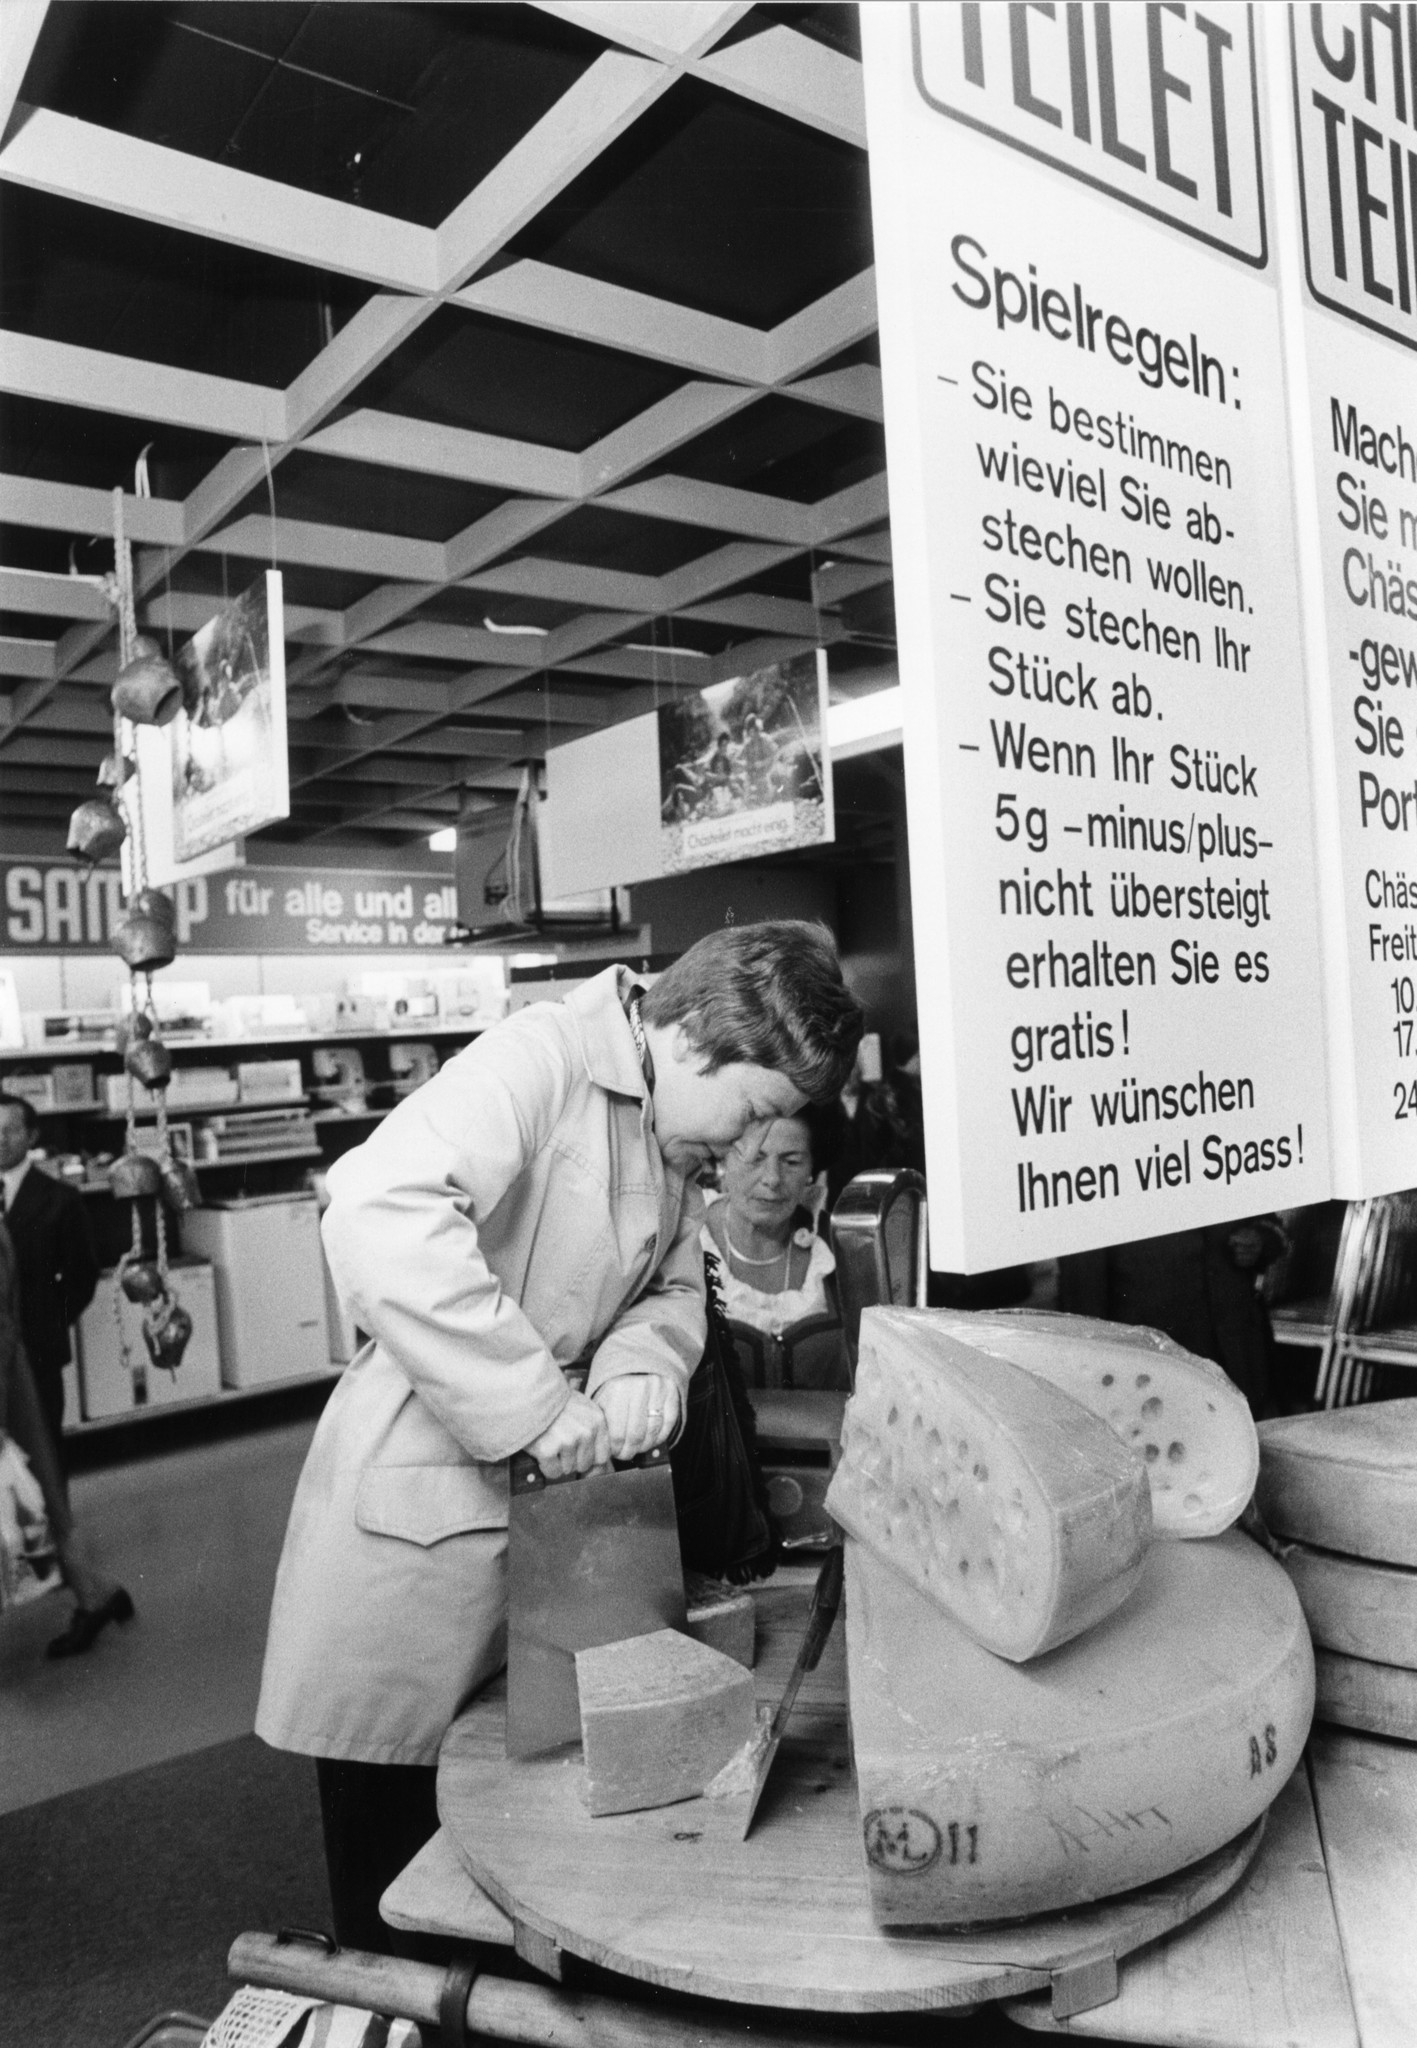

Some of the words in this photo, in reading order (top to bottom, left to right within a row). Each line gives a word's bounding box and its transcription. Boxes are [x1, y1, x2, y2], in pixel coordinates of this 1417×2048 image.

[951, 235, 1240, 410] Spielregeln:
[972, 361, 1032, 421] Sie
[1049, 386, 1231, 489] bestimmen
[977, 442, 1106, 511] wieviel
[1120, 476, 1171, 530] Sie
[1187, 502, 1234, 545] ab-
[1337, 472, 1387, 540] Sie
[982, 509, 1131, 583] stechen
[1147, 558, 1253, 614] wollen.
[985, 573, 1045, 630] Sie
[1066, 597, 1200, 663] stechen
[1214, 625, 1250, 673] Ihr
[988, 645, 1098, 710] Stück
[1112, 673, 1162, 720] ab.
[990, 719, 1095, 778] Wenn
[1113, 736, 1154, 784] Ihr
[1170, 744, 1258, 798] Stück
[1354, 695, 1404, 758] Sie
[225, 879, 273, 916] für
[284, 881, 343, 918] alle
[354, 884, 413, 919] und
[306, 918, 382, 945] Service
[388, 920, 408, 944] in
[1000, 867, 1093, 917] nicht
[1111, 872, 1270, 928] übersteigt
[1007, 940, 1156, 989] erhalten
[1171, 939, 1219, 985] Sie
[1235, 951, 1270, 983] es
[1011, 1009, 1129, 1072] gratis!
[1011, 1085, 1072, 1136] Wir
[1091, 1070, 1254, 1127] wünschen
[1018, 1162, 1119, 1212] Ihnen
[1135, 1139, 1190, 1191] viel
[1203, 1124, 1303, 1185] Spass!
